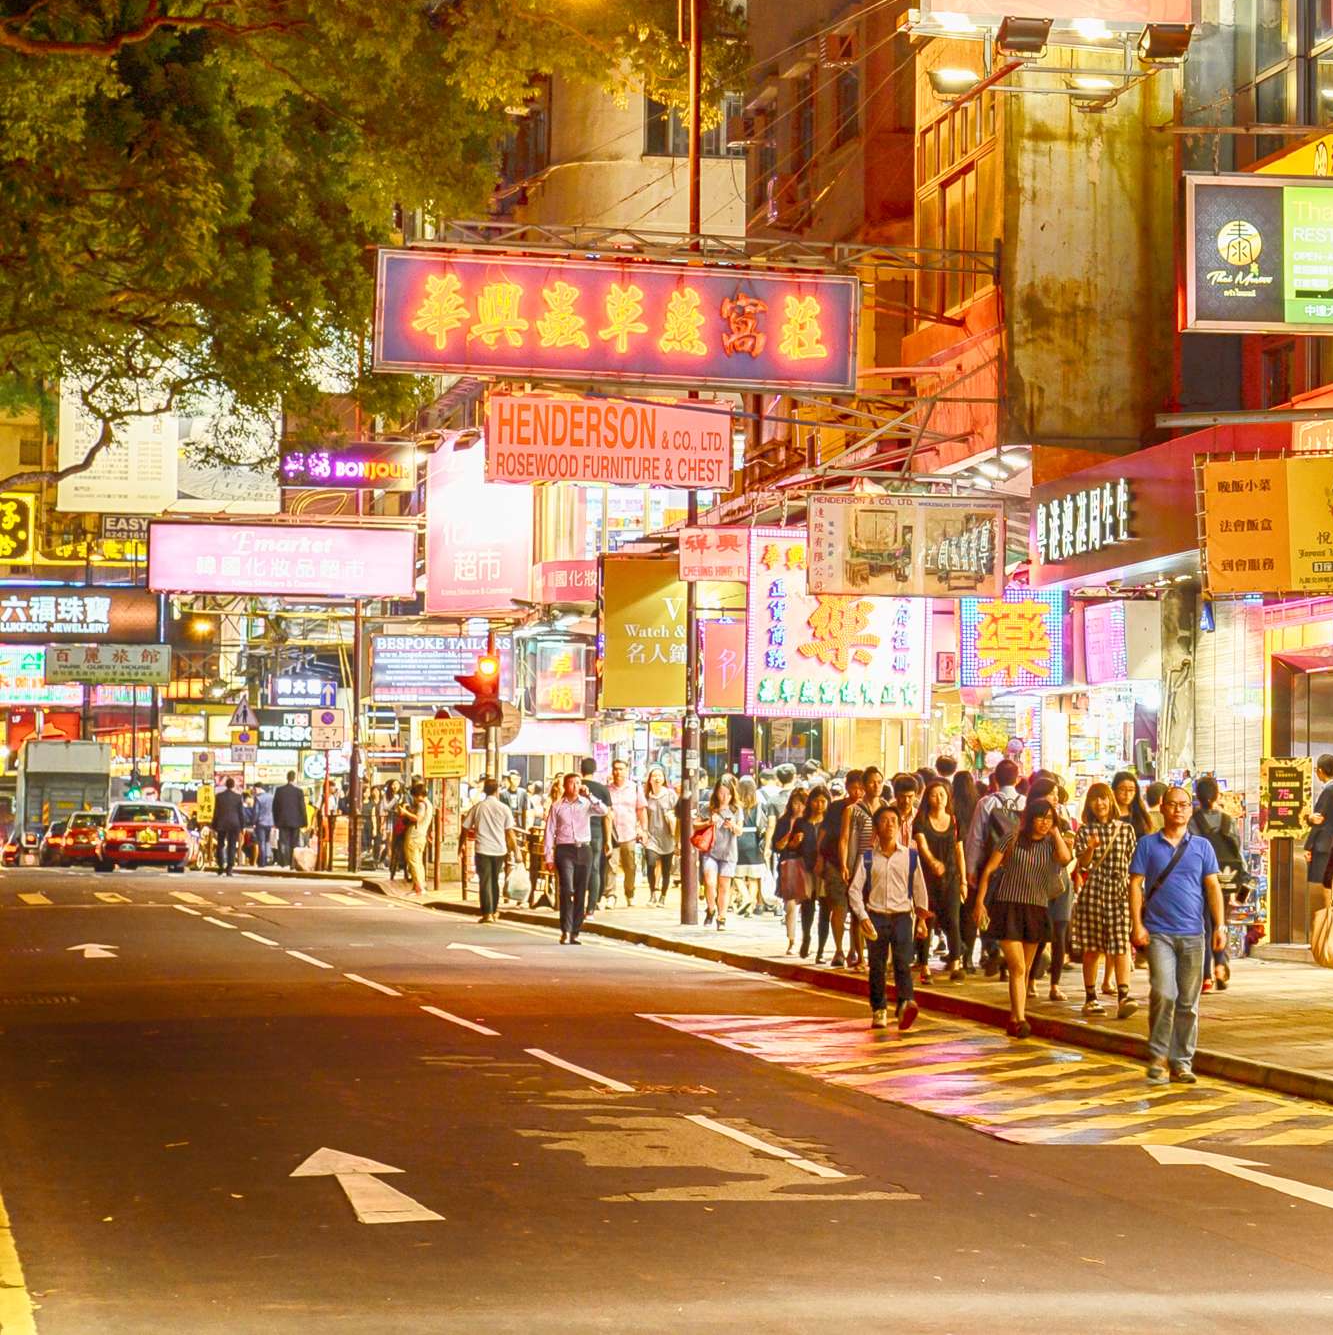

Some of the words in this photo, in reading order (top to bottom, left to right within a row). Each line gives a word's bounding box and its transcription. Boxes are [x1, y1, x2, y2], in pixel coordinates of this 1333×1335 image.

[498, 401, 657, 451] HENDERSON
[661, 430, 671, 451] &
[672, 430, 698, 452] CO.,
[700, 430, 726, 453] LTD.
[334, 460, 411, 479] BONJOUR
[495, 453, 580, 478] ROSEWOOD
[583, 454, 661, 480] FURNITURE
[663, 461, 674, 479] &
[677, 458, 724, 483] CHEST
[1217, 478, 1273, 494] 晚飯小菜
[813, 496, 866, 506] HENDERSON
[105, 516, 149, 531] EASY
[453, 549, 502, 582] 超市
[50, 622, 110, 634] JEWELLERY
[625, 622, 670, 638] Watch
[673, 623, 686, 638] &
[375, 637, 445, 650] BESPOKE
[86, 663, 118, 671] GUEST
[121, 663, 153, 671] HOUSE
